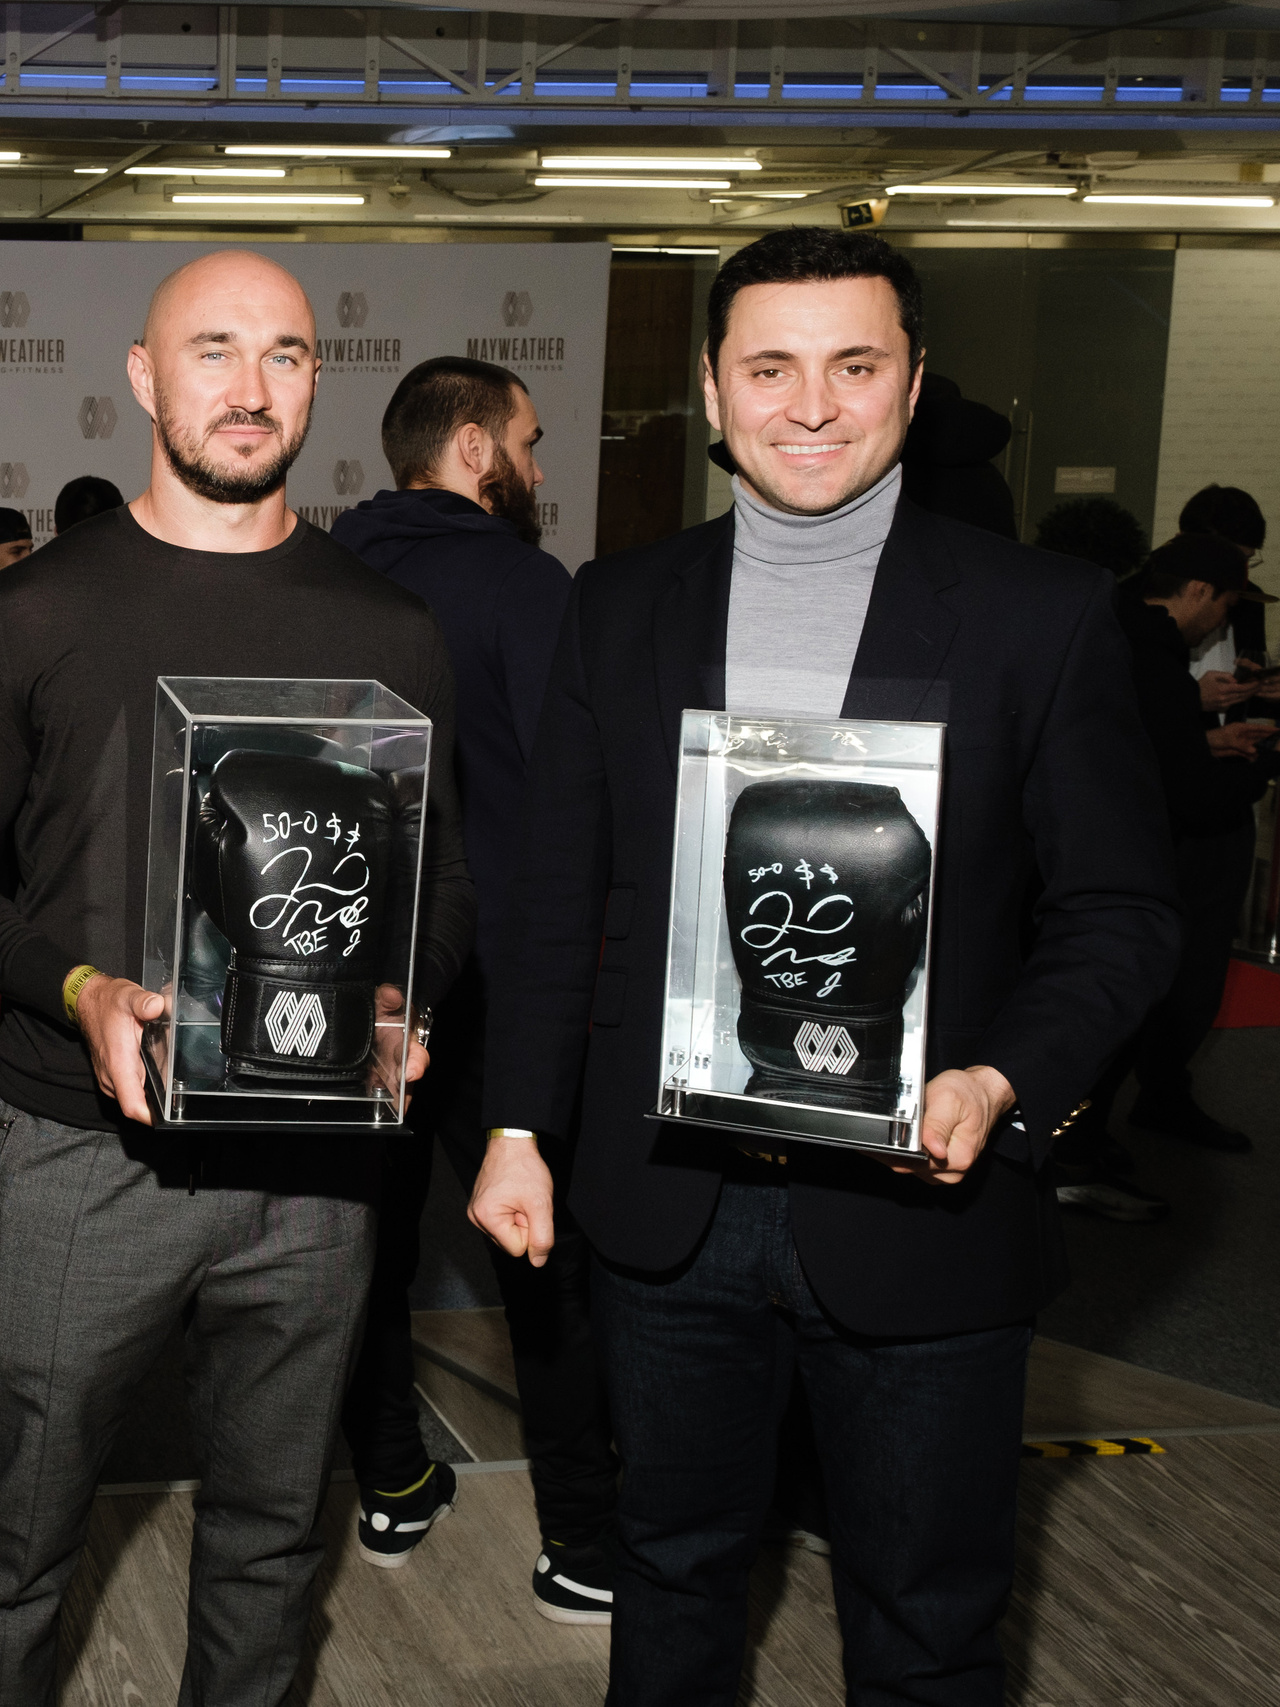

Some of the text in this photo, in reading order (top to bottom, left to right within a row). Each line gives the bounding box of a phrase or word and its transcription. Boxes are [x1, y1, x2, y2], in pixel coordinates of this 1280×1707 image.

[316, 339, 401, 361] AYWEATHER
[467, 338, 564, 360] MAYWEATHER
[262, 811, 318, 843] 50-0
[748, 862, 783, 882] 50-0
[284, 926, 329, 956] TBE
[764, 971, 808, 989] TBE
